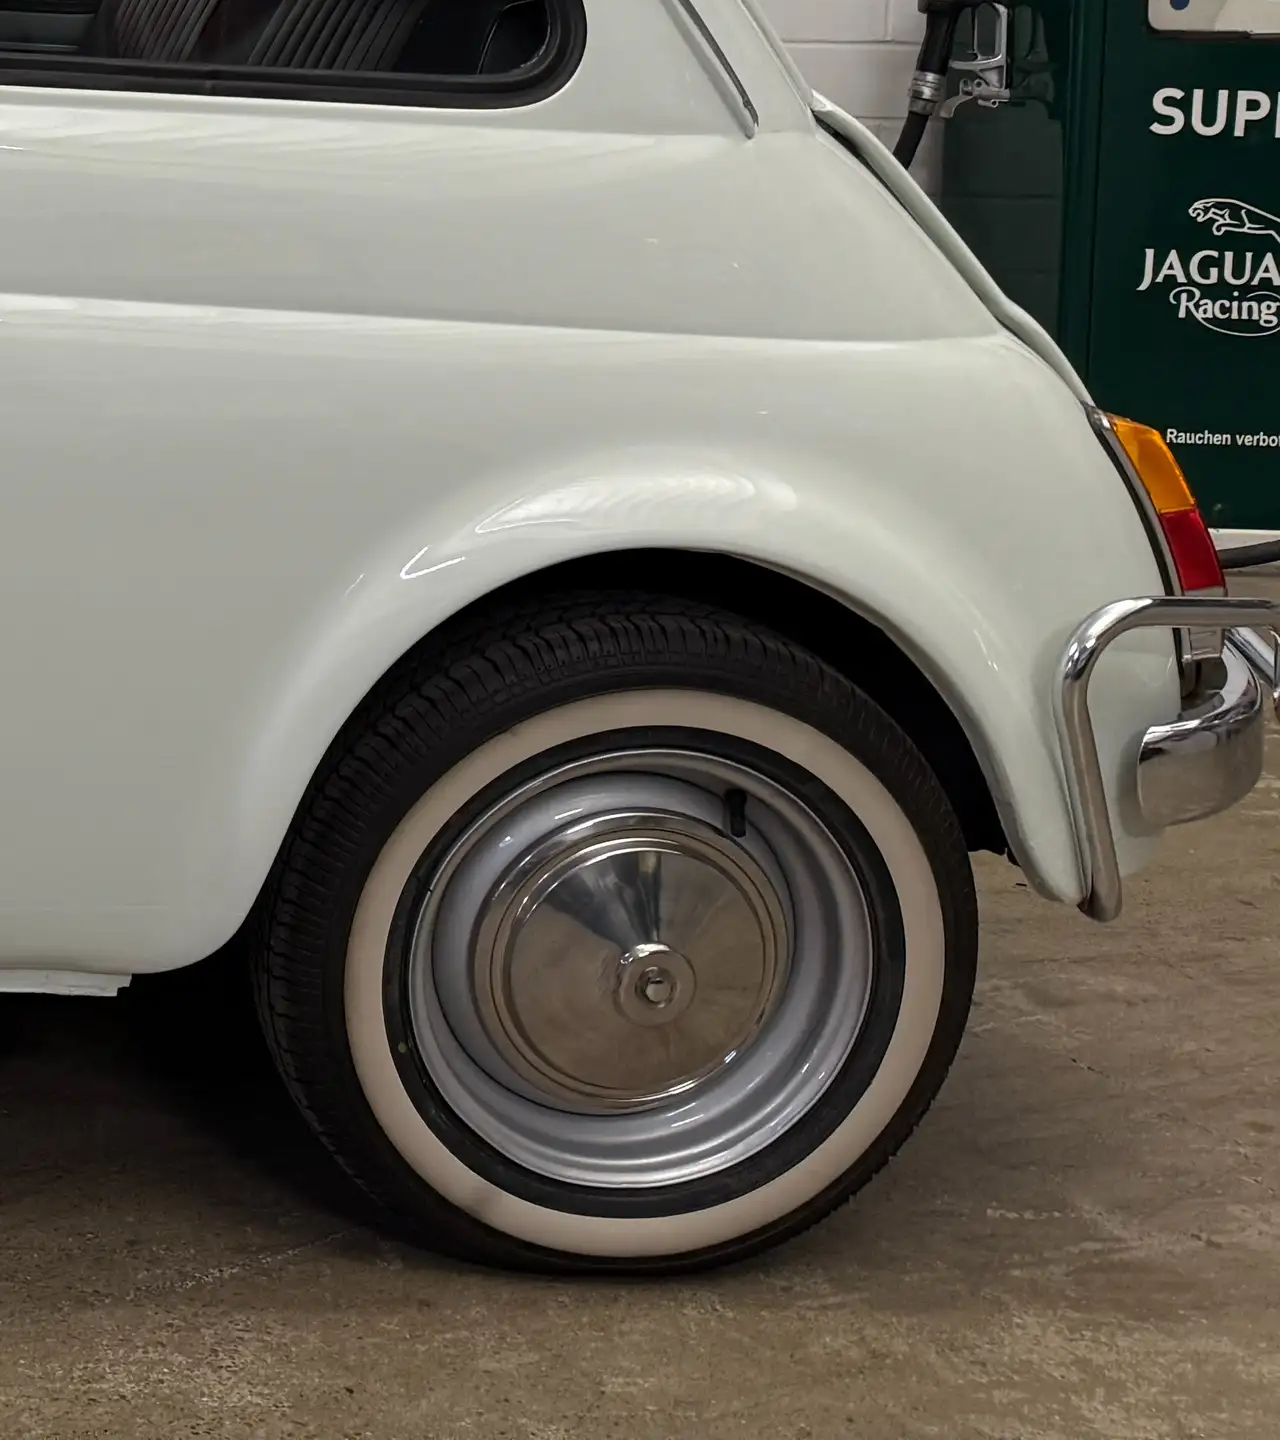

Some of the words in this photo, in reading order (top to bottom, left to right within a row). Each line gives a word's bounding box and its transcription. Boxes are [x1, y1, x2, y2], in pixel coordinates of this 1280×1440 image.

[1149, 87, 1280, 138] SUP
[1136, 248, 1280, 290] JAGUA
[1169, 286, 1280, 329] Racing
[1166, 428, 1231, 445] Rauchen
[1236, 431, 1280, 447] verbo
